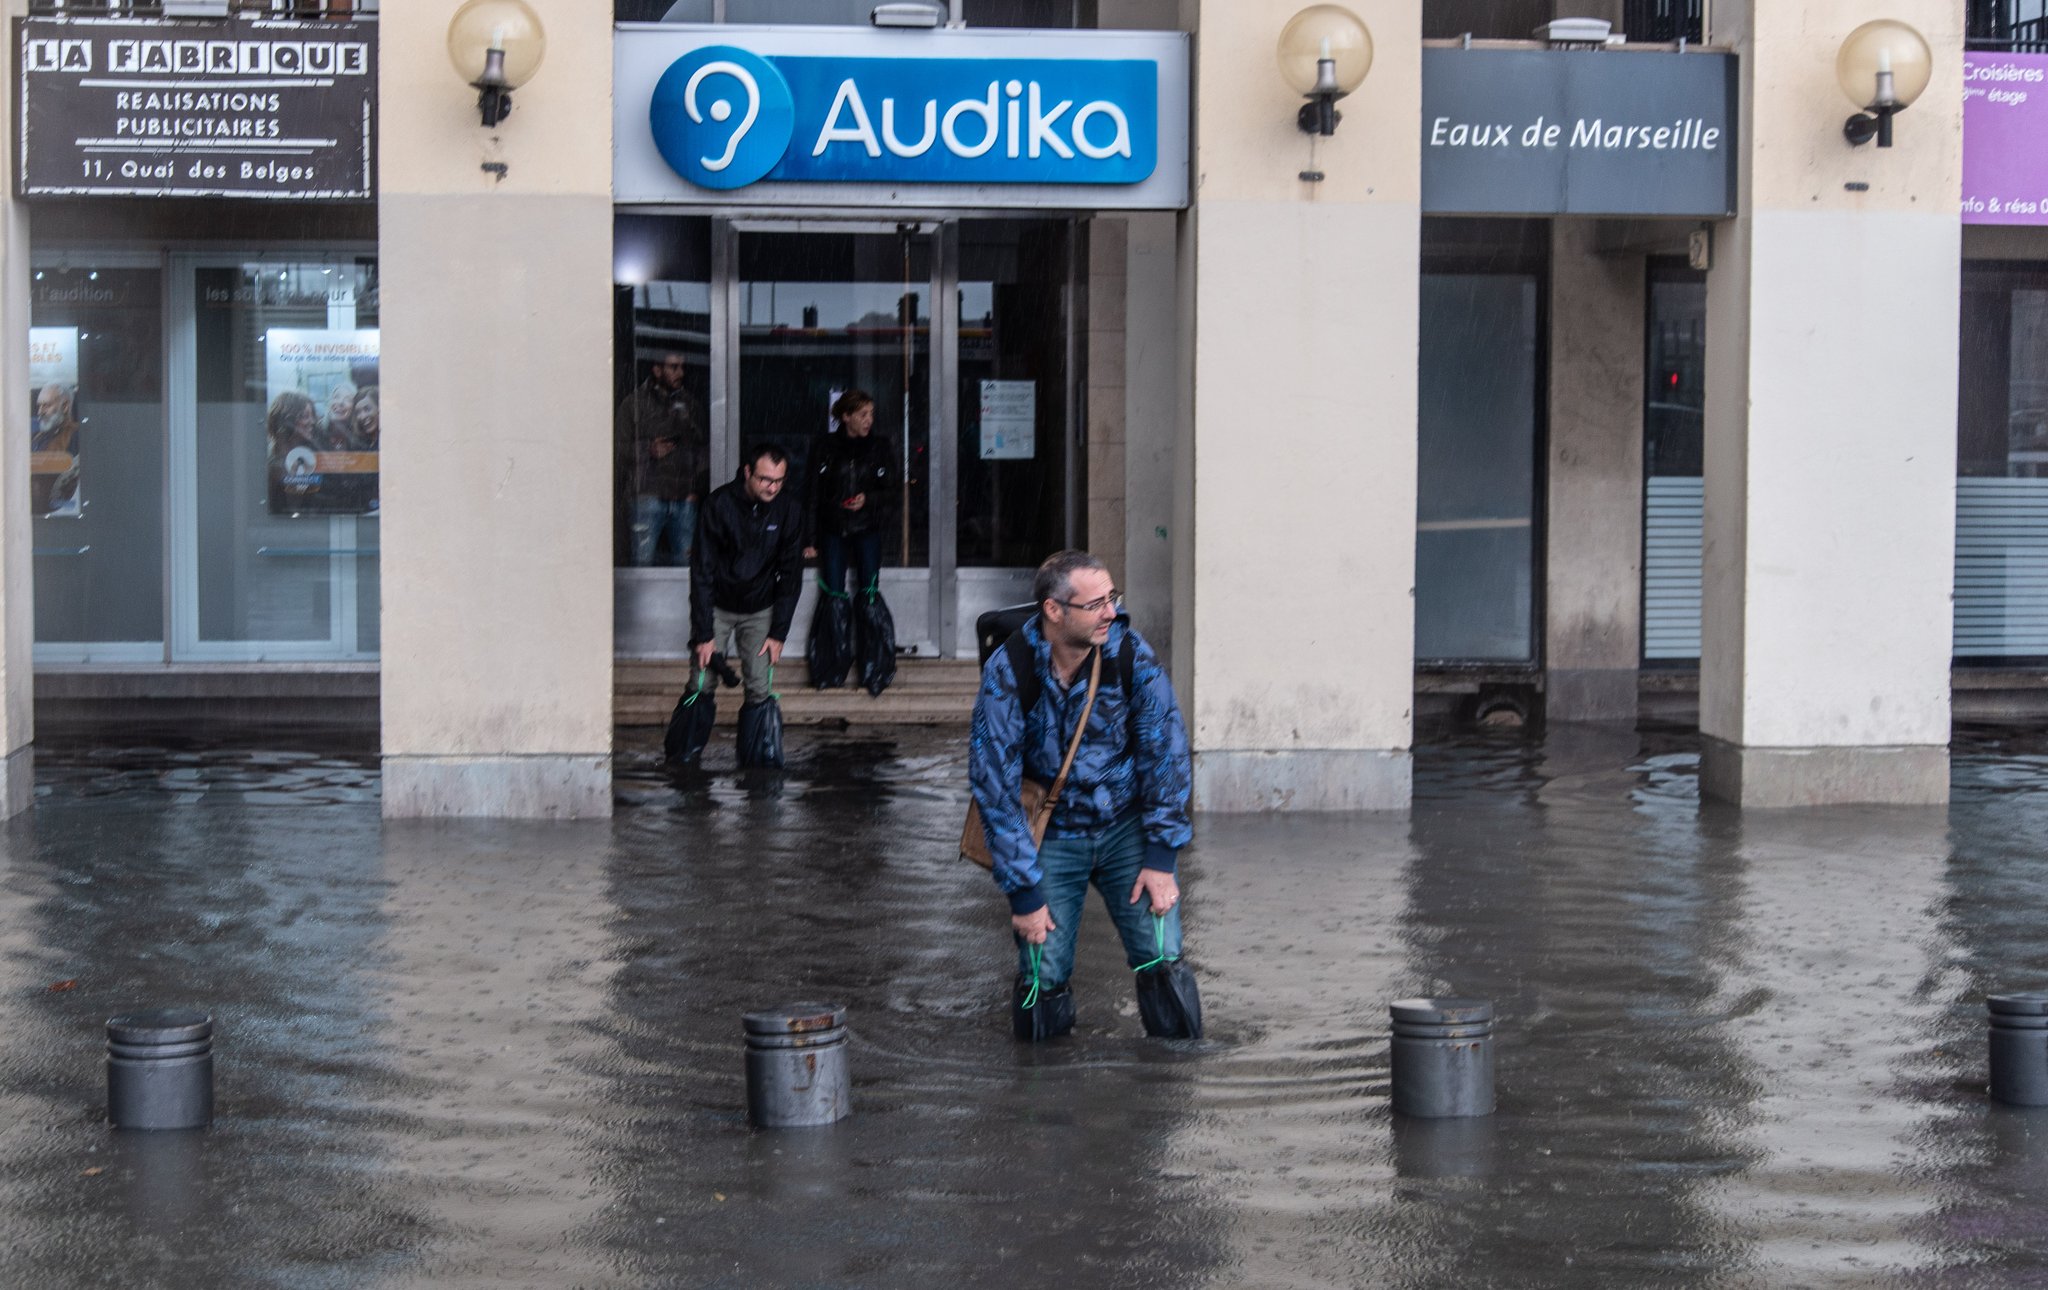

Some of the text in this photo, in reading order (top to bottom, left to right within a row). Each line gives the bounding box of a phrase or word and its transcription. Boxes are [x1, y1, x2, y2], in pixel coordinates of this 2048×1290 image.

[30, 41, 367, 73] LA FABRIQUE
[1963, 62, 2044, 83] Croisières
[116, 92, 280, 112] REALISATIONS
[1988, 87, 2028, 106] étage
[116, 117, 280, 137] PUBLICITAIRES
[811, 77, 1132, 159] Audika
[1430, 116, 1720, 150] Eaux de Marseille
[83, 159, 315, 183] 11, Quai des Belges
[1960, 195, 1985, 214] nfo
[1988, 197, 2002, 214] &
[2004, 197, 2037, 215] résa
